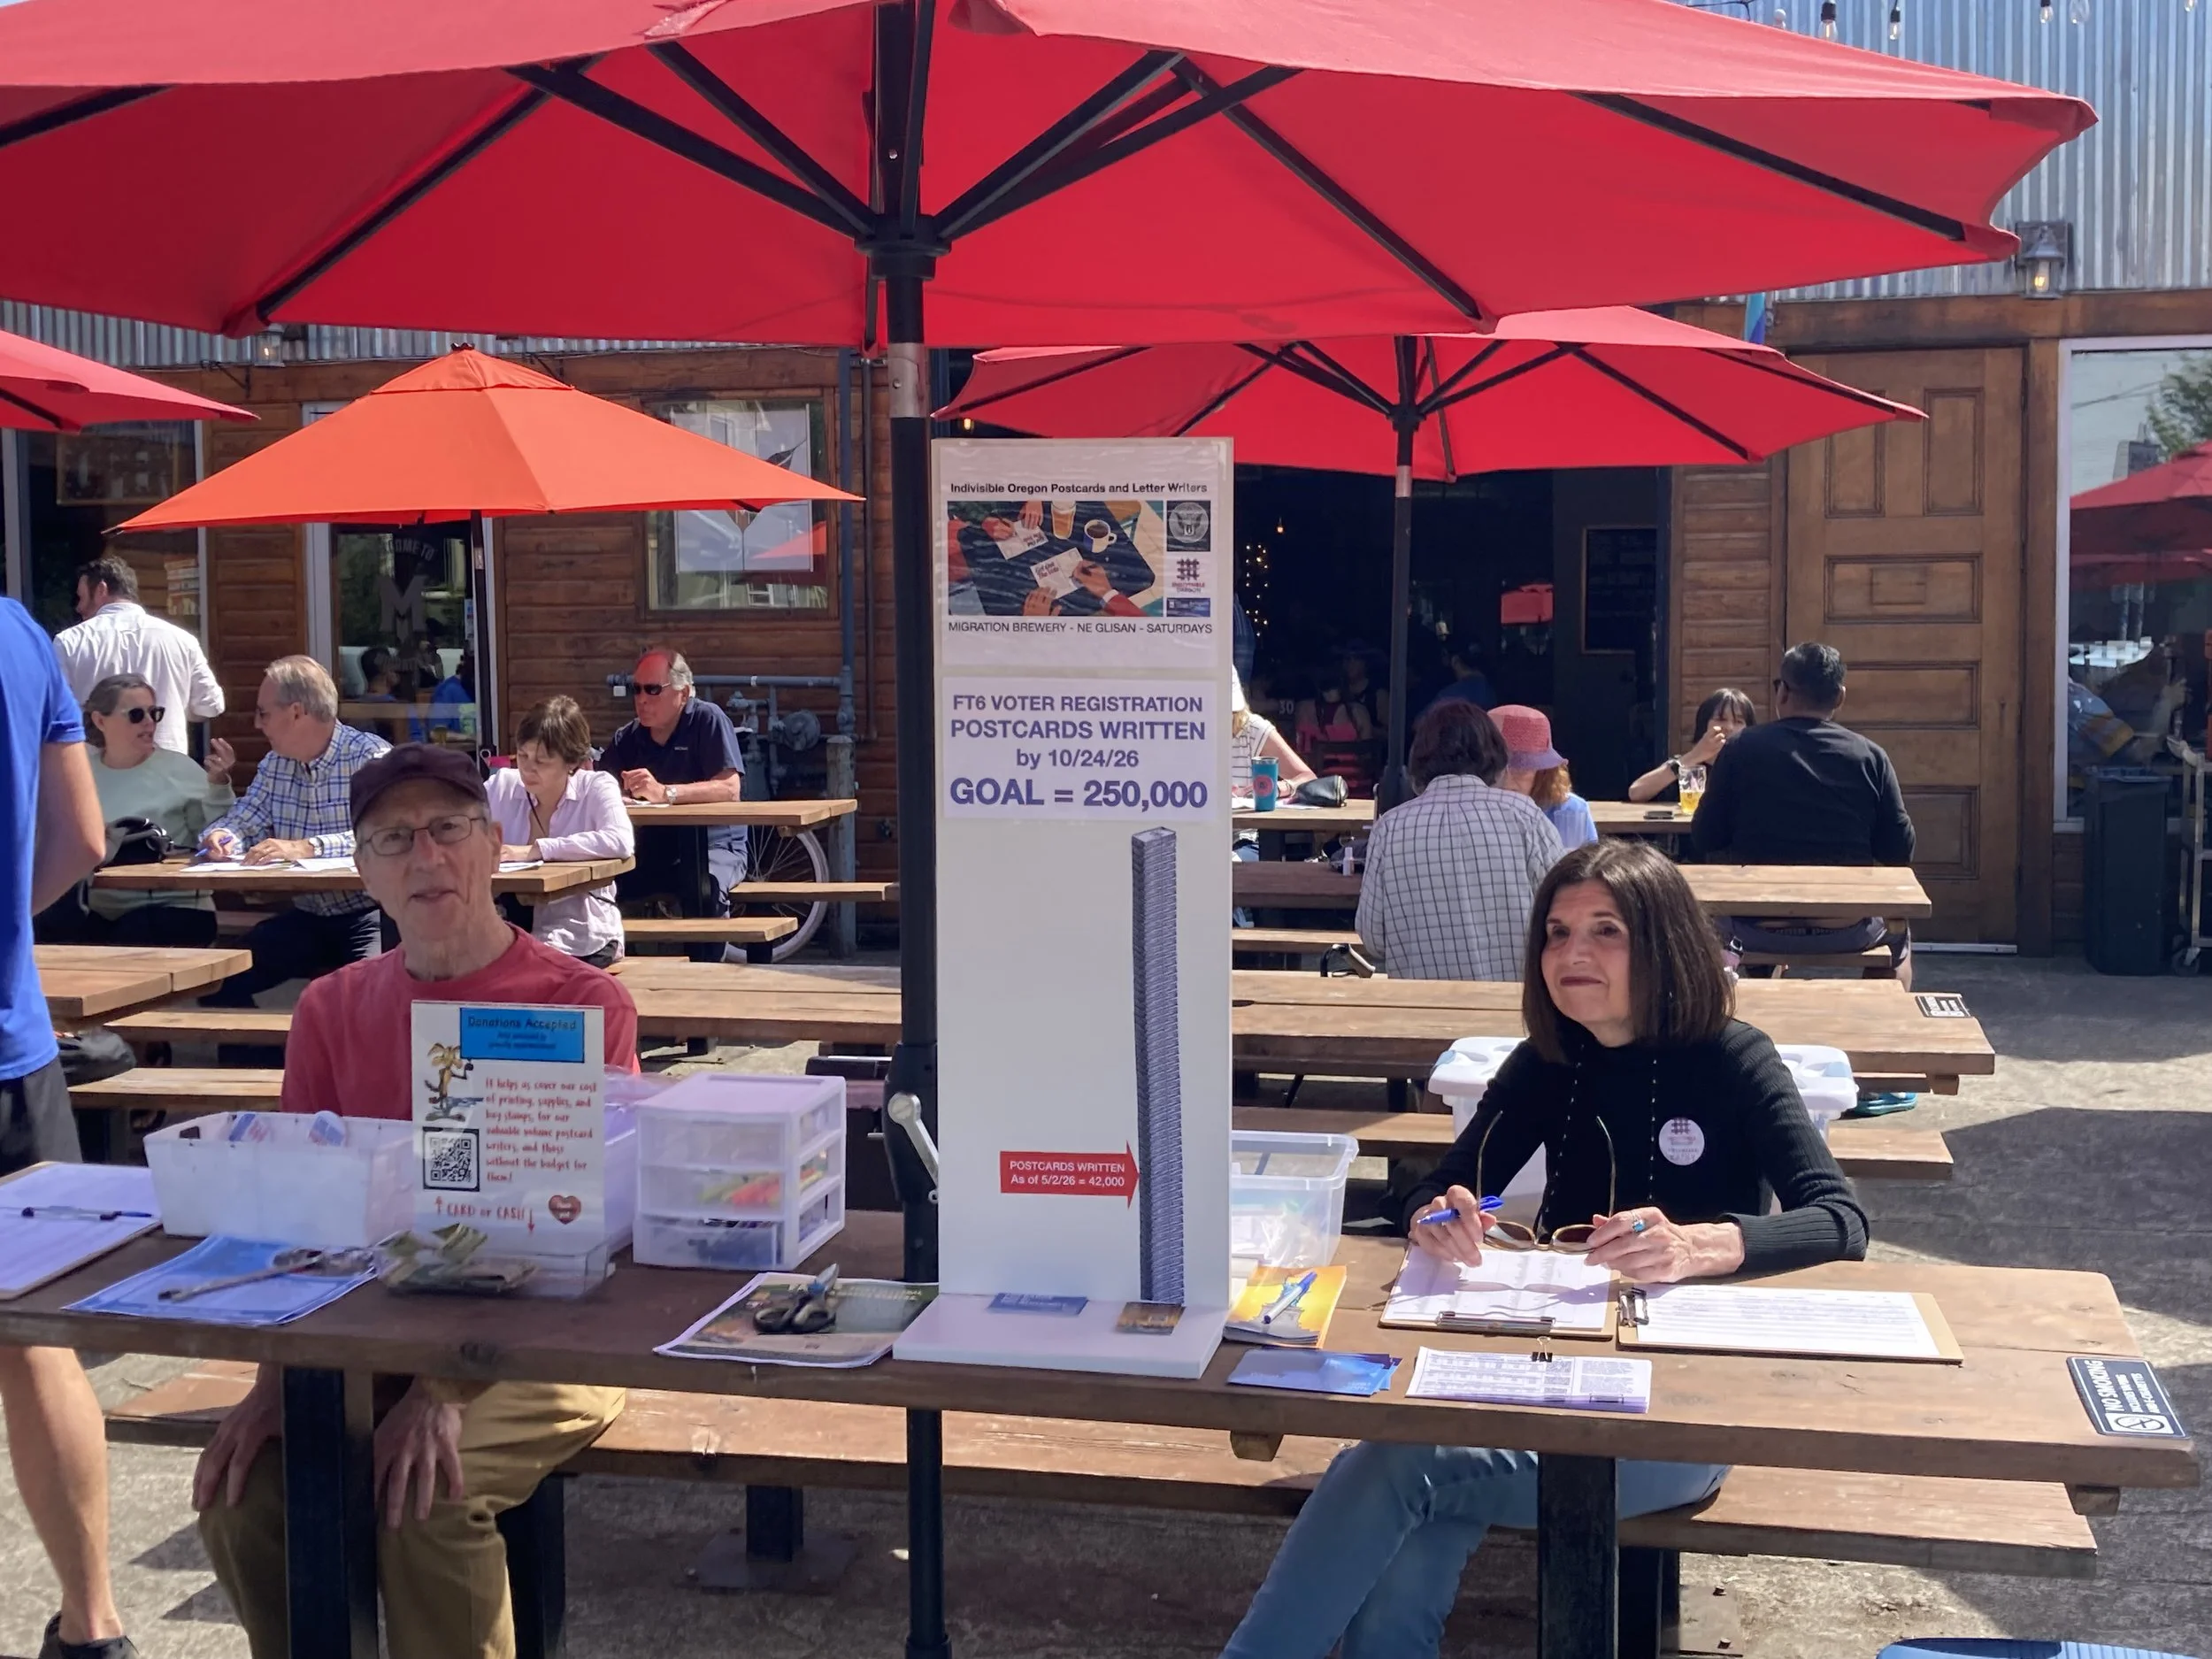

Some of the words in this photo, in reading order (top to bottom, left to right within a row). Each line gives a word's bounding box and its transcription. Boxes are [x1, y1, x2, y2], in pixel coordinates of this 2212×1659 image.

[950, 483, 1005, 493] Indivisible
[1008, 483, 1048, 495] Oregon
[1051, 483, 1106, 493] Postcards
[1109, 483, 1130, 493] and
[1133, 483, 1165, 493] Letter
[1168, 483, 1207, 493] Writers
[949, 622, 1010, 633] MIGRATION
[1012, 623, 1067, 633] BREWERY
[1077, 623, 1093, 634] NE
[1095, 623, 1136, 634] GLISAN
[1147, 623, 1212, 634] SATURDAYS
[953, 695, 986, 710] FT6
[991, 695, 1055, 711] VOTER
[1061, 696, 1202, 712] REGISTRATION
[951, 719, 1093, 739] POSTCARDS
[1100, 721, 1205, 740] WRITTEN
[1017, 749, 1041, 770] by
[1048, 749, 1139, 768] 10/24/26
[950, 778, 1044, 805] GOAL
[1055, 789, 1073, 803] =
[1083, 780, 1208, 812] 250,000
[468, 1015, 521, 1026] Donations
[526, 1018, 577, 1032] Accepted
[486, 1078, 493, 1088] It
[497, 1079, 518, 1090] helps
[580, 1082, 596, 1092] cost
[486, 1093, 495, 1102] of
[576, 1096, 591, 1107] and
[538, 1111, 550, 1121] for
[556, 1128, 593, 1141] postcard
[522, 1141, 538, 1151] and
[487, 1157, 518, 1166] without
[524, 1158, 536, 1167] the
[541, 1158, 570, 1171] budget
[574, 1159, 587, 1170] for
[1010, 1161, 1074, 1171] POSTCARDS
[1077, 1162, 1125, 1172] WRITTEN
[1010, 1175, 1025, 1184] As
[1028, 1175, 1039, 1184] of
[1041, 1175, 1075, 1185] 5/2/26
[1088, 1176, 1125, 1187] 42,000
[447, 1203, 475, 1217] CARD
[496, 1206, 525, 1220] CASH
[2084, 1360, 2117, 1399] SMOKING
[2101, 1399, 2124, 1411] NO
